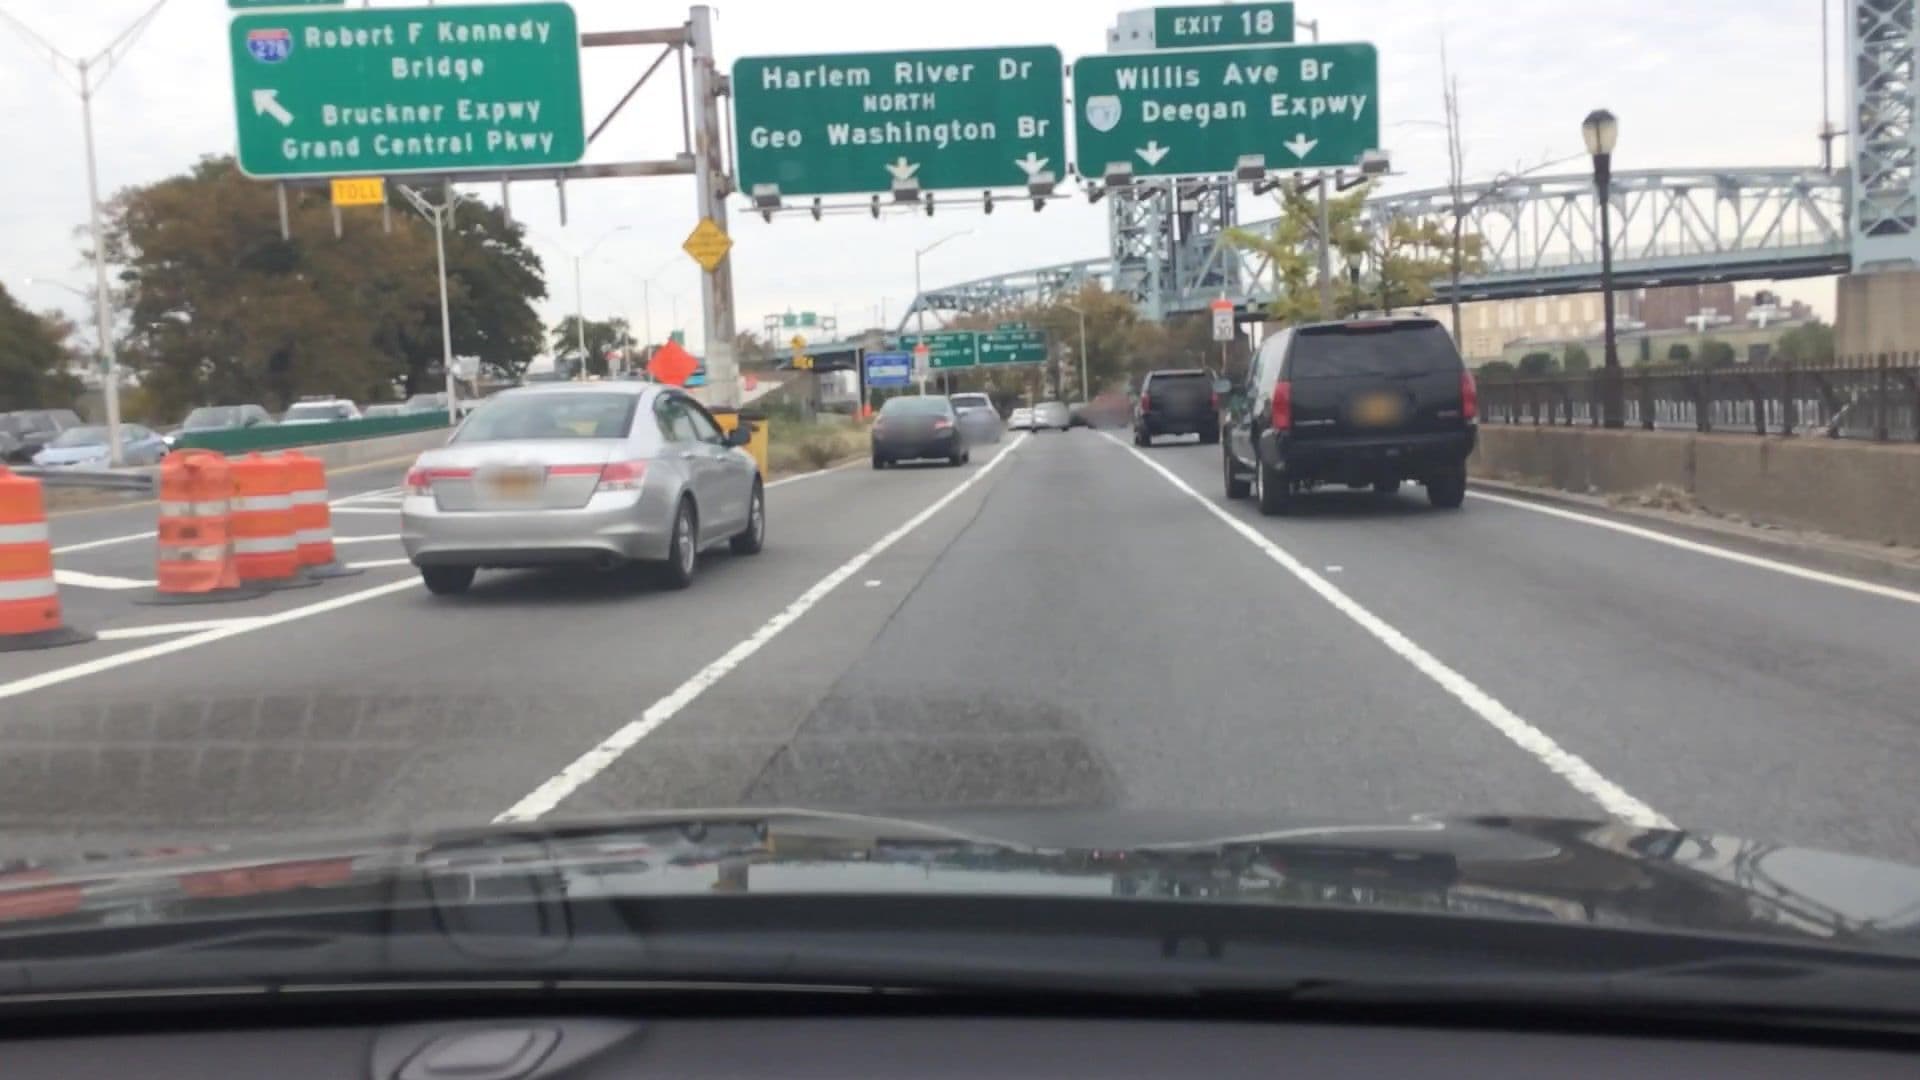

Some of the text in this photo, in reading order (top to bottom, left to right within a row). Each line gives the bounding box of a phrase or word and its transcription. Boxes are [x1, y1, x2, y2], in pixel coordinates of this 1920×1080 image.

[305, 20, 551, 48] Robert F Kennedy
[1173, 10, 1275, 35] EXIT 18
[391, 56, 484, 81] Bridge
[762, 58, 1033, 90] Harlem River Dr
[1115, 58, 1334, 91] Willis Ave Br
[322, 98, 541, 127] Bruckner Expwy
[863, 92, 936, 113] NORTH
[1142, 100, 1246, 128] Deegan
[1270, 93, 1367, 121] Expwy
[282, 130, 554, 160] Grand Central Pkwy
[750, 116, 1050, 149] Geo Washington Br
[337, 183, 378, 200] TOLL
